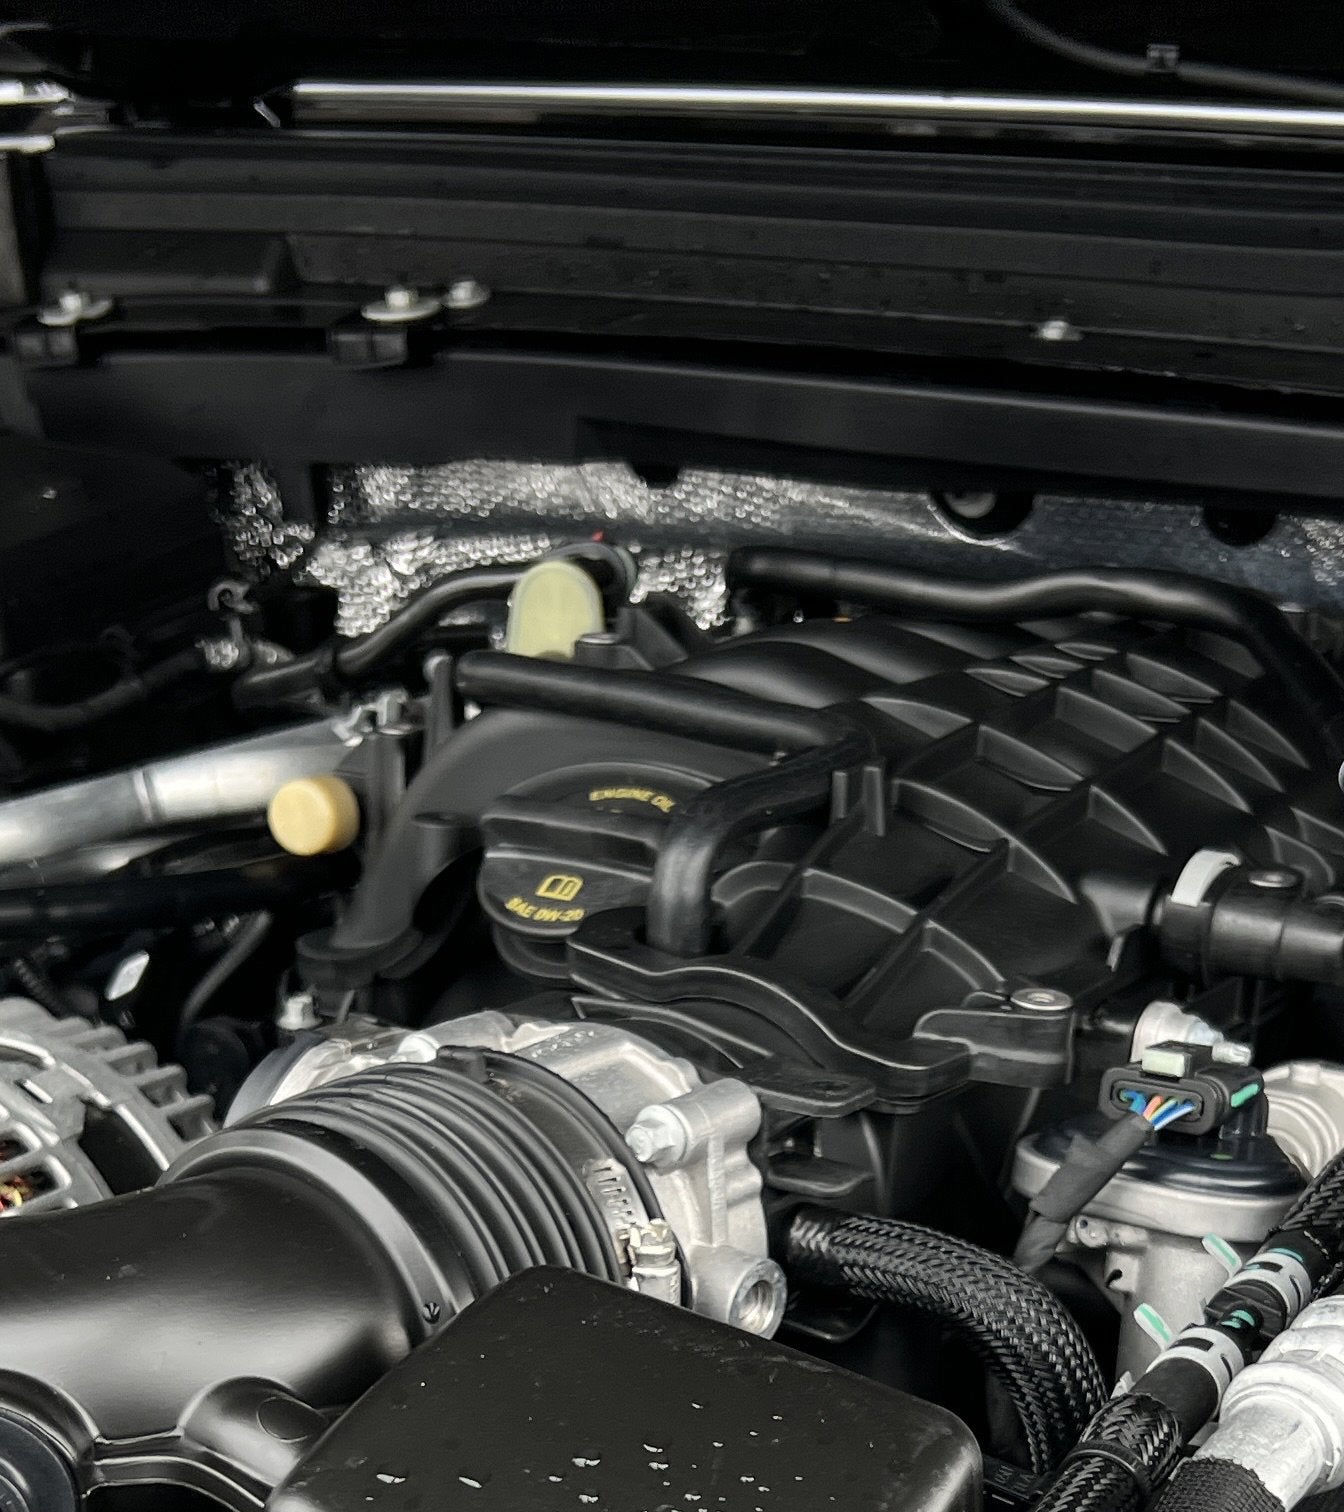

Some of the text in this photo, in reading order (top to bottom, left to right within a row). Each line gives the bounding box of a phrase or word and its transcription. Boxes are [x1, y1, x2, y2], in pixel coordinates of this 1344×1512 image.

[589, 788, 676, 813] ENGINE OIL
[505, 897, 585, 922] SAE 0W-20
